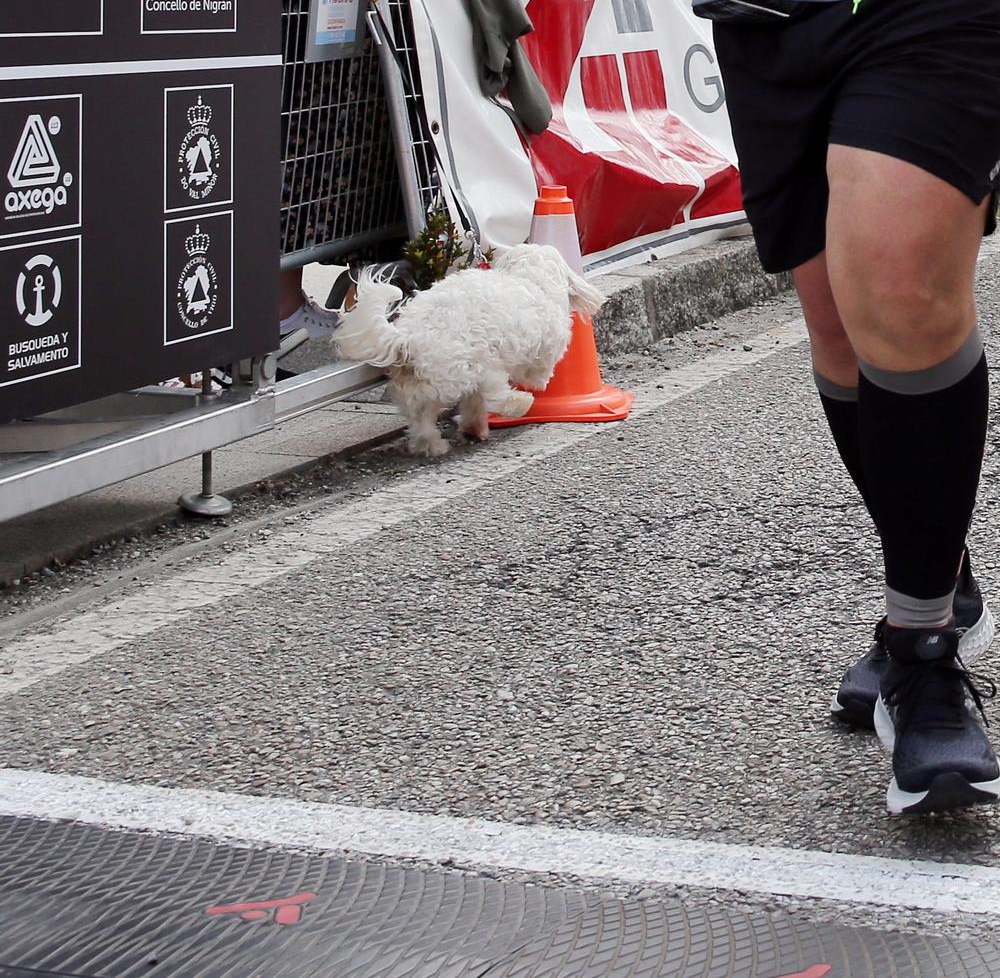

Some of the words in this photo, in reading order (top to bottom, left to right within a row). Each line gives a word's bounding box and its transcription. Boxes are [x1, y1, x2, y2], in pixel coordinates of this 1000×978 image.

[178, 125, 210, 163] PROTECCIÓN
[210, 134, 221, 159] CIVIL
[4, 186, 67, 214] axega
[8, 336, 61, 356] BUSQUEDA
[61, 332, 69, 345] Y
[7, 347, 69, 372] SALVAMENTO
